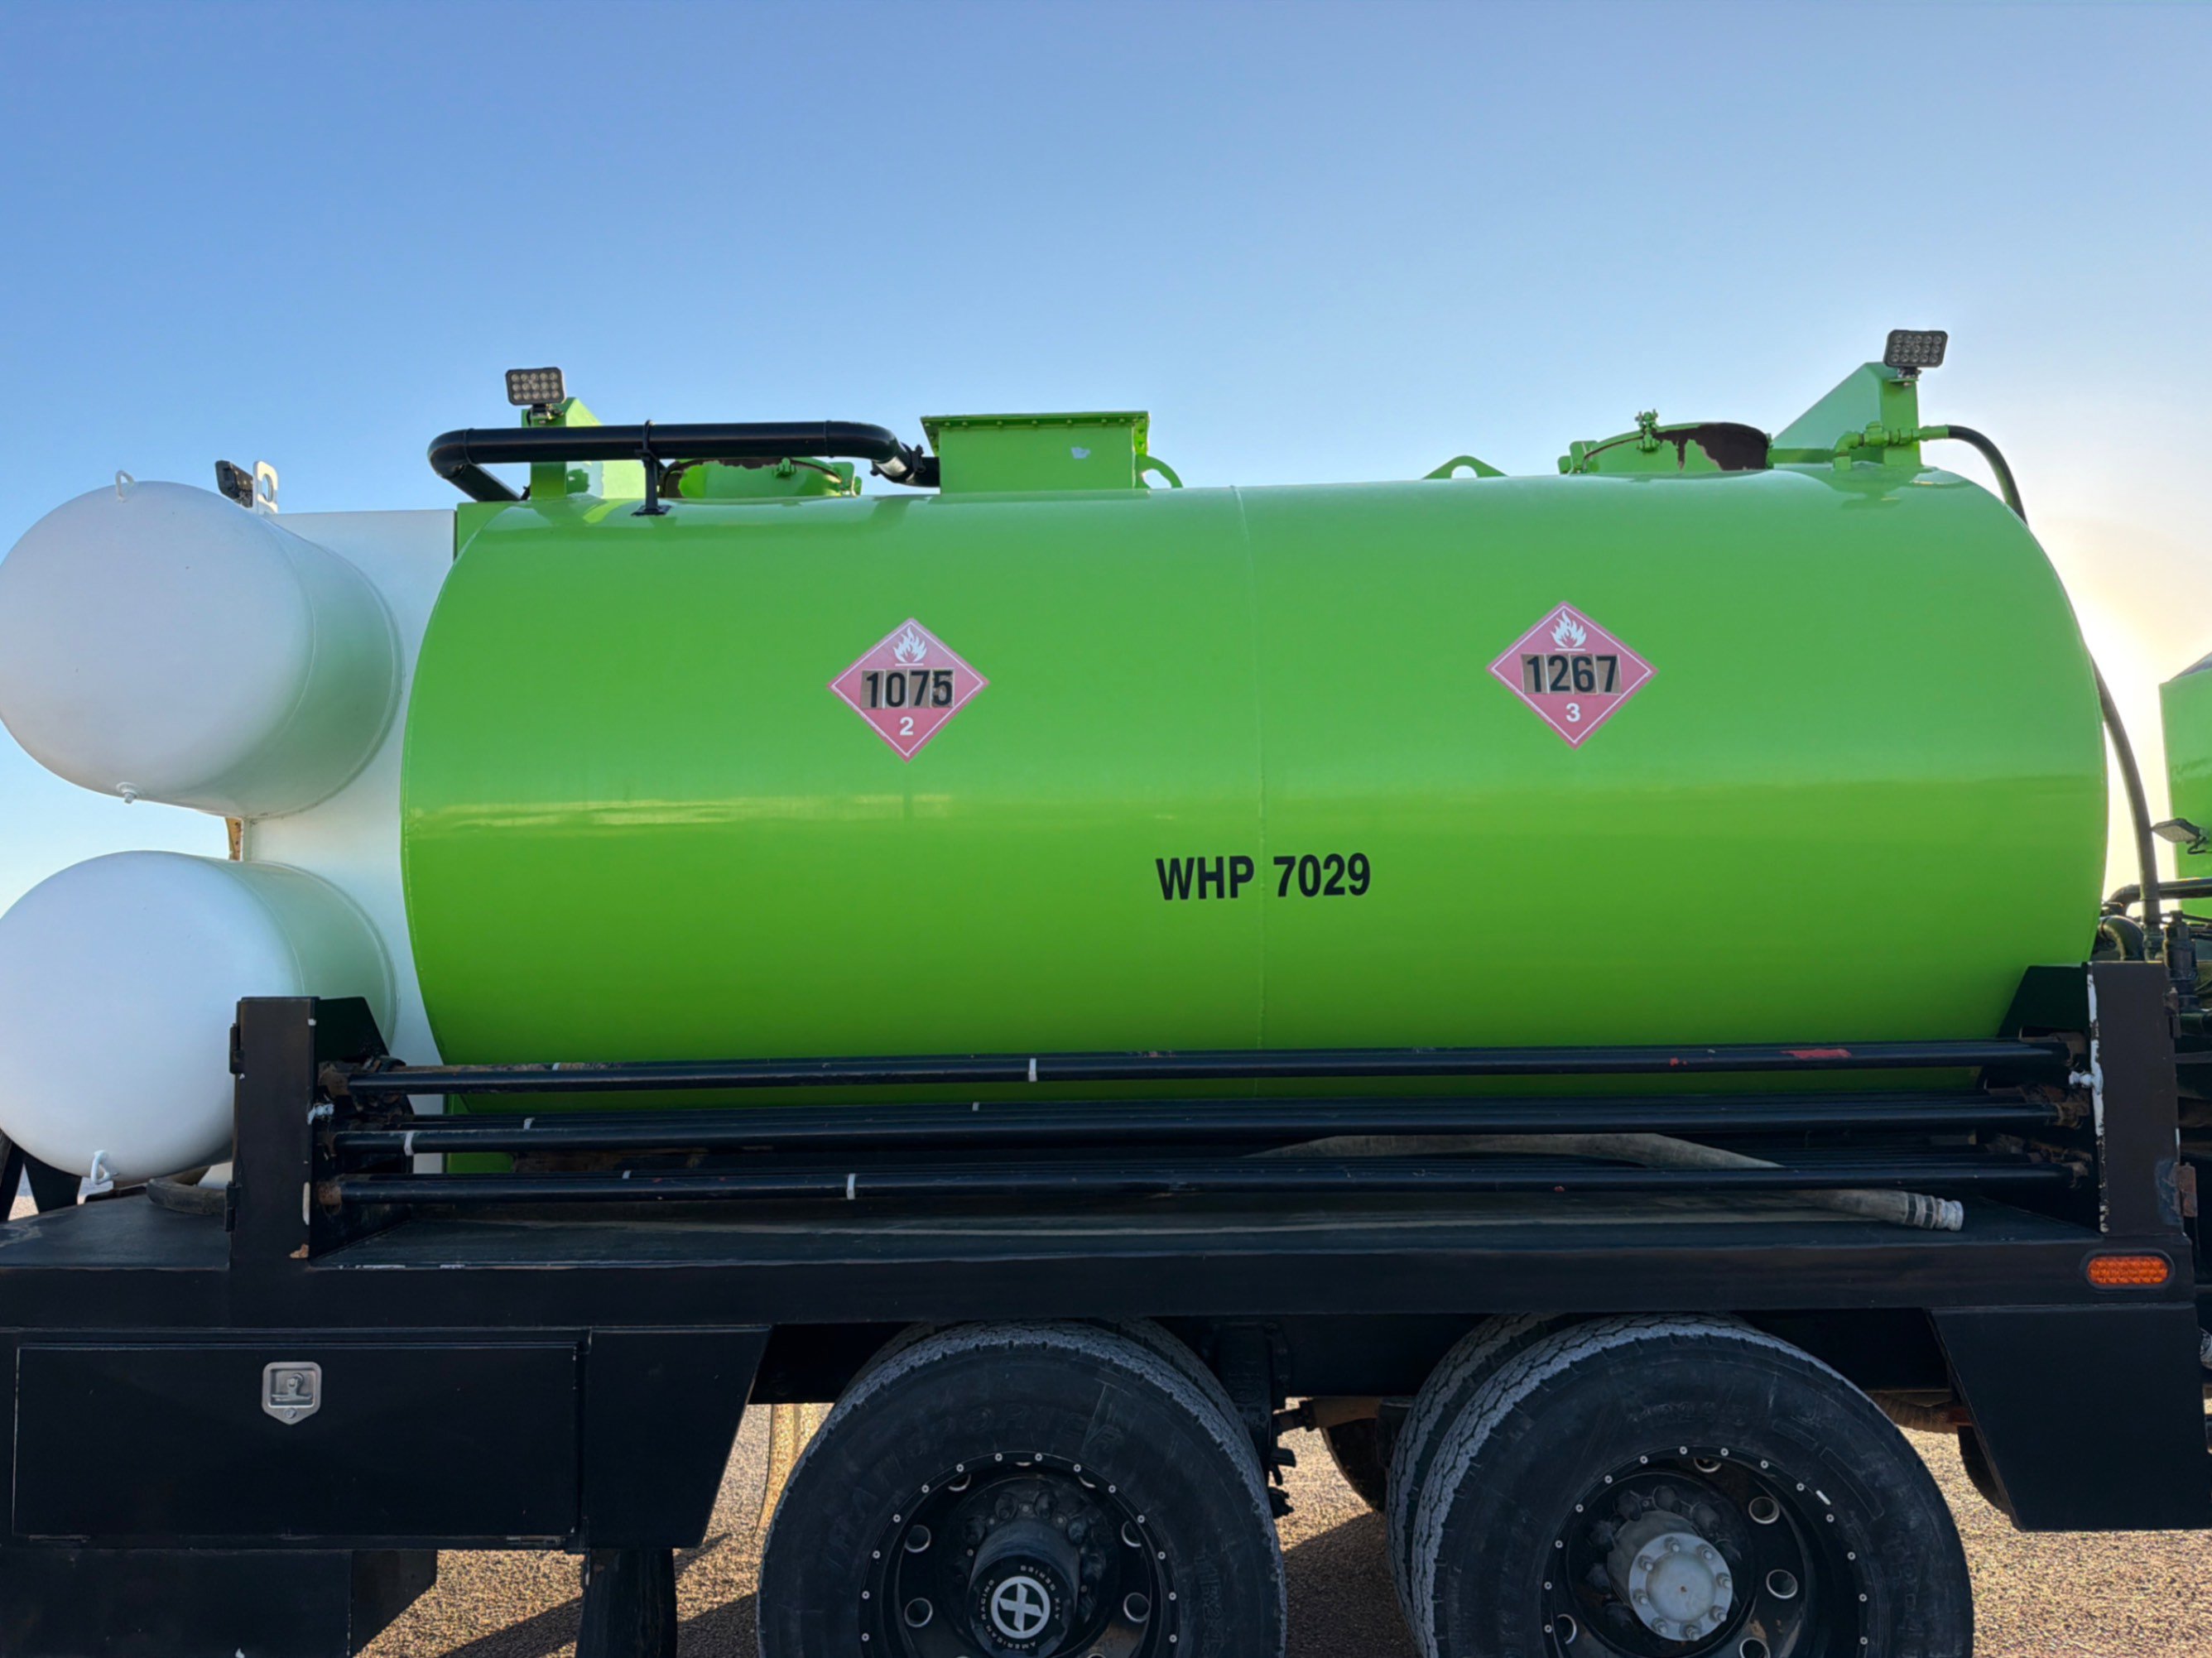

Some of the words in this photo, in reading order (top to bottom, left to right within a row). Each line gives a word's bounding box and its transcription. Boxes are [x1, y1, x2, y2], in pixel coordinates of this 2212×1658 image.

[866, 670, 953, 709] 1075
[1527, 654, 1618, 694] 1267
[899, 716, 914, 736] 2
[1565, 702, 1581, 723] 3
[1155, 855, 1255, 901] WHP
[1273, 852, 1371, 898] 7029
[980, 1579, 995, 1621] RACING
[985, 1625, 1036, 1650] AMERICAN
